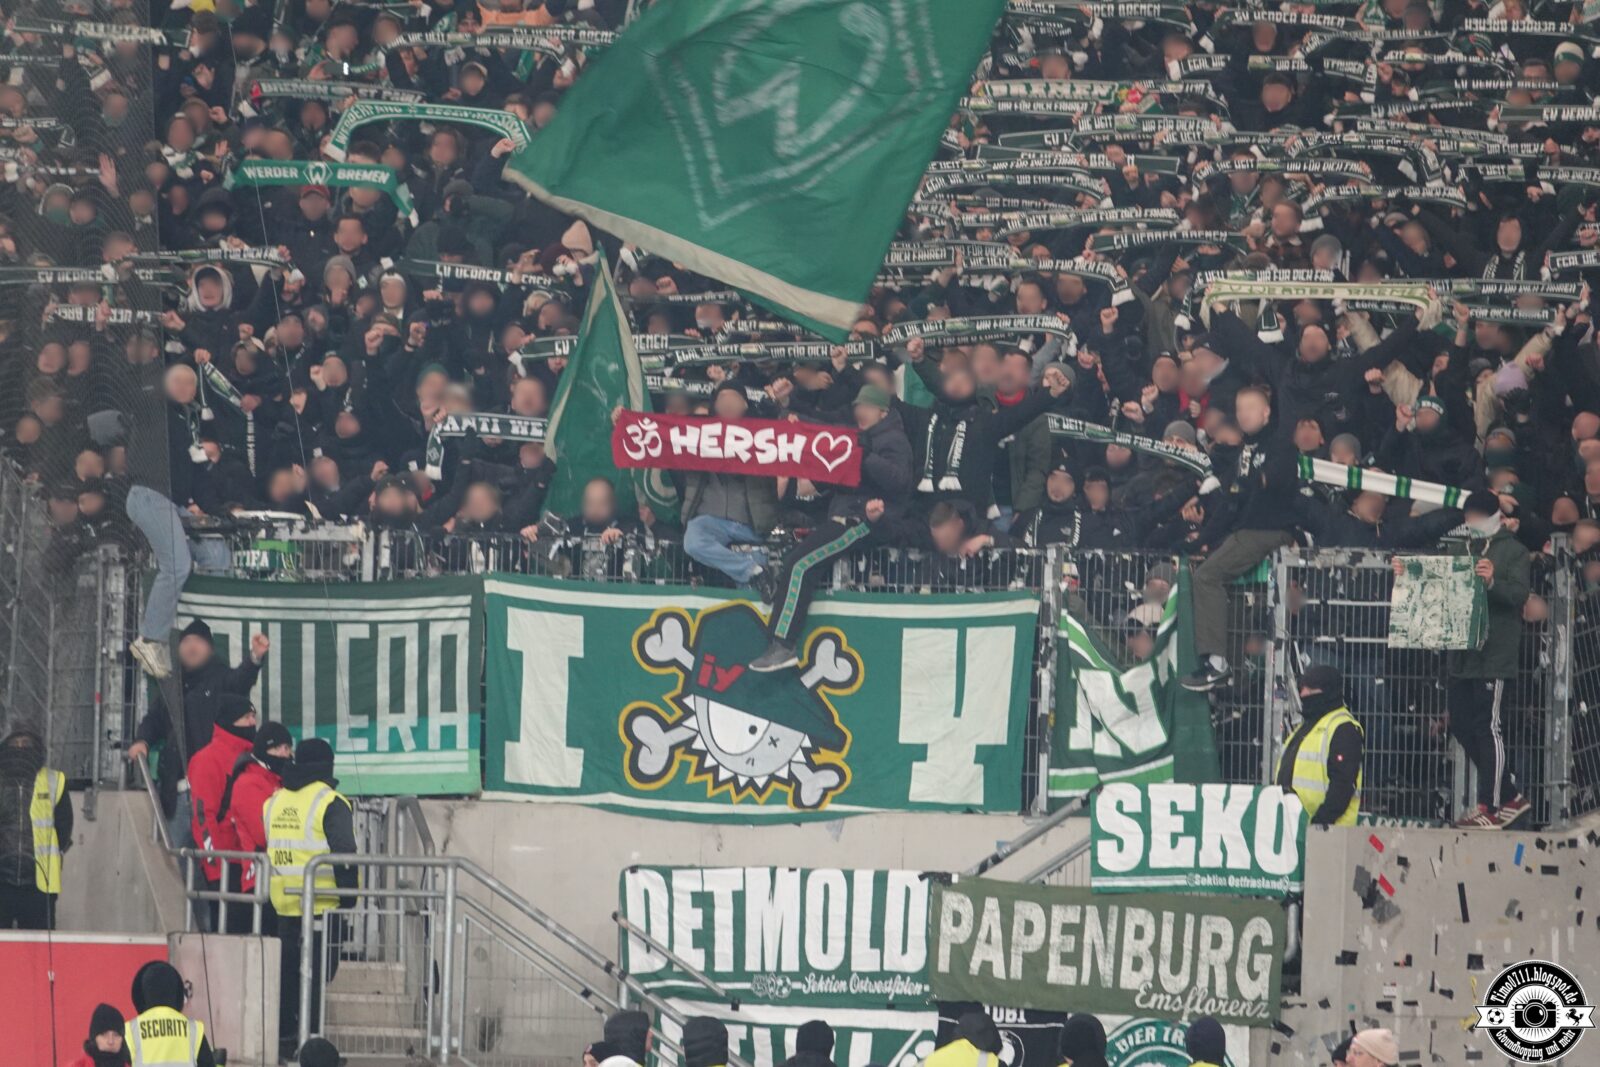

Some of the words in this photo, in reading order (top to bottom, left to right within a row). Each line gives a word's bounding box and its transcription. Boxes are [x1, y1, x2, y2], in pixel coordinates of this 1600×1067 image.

[1119, 3, 1161, 18] BREMEN
[243, 166, 299, 179] WERDER
[336, 168, 390, 184] BREMEN
[1062, 417, 1084, 431] WEIT
[669, 421, 808, 465] HERSH
[503, 605, 585, 789] I
[1096, 781, 1304, 875] SEKO
[274, 850, 293, 865] 0034
[624, 866, 930, 974] DETMOLD
[937, 890, 1274, 1000] PAPENBURG
[802, 974, 849, 995] Sektion
[849, 971, 922, 1000] Ostwestfalen
[1135, 980, 1271, 1023] Emsflorenz
[139, 1018, 189, 1039] SECURITY
